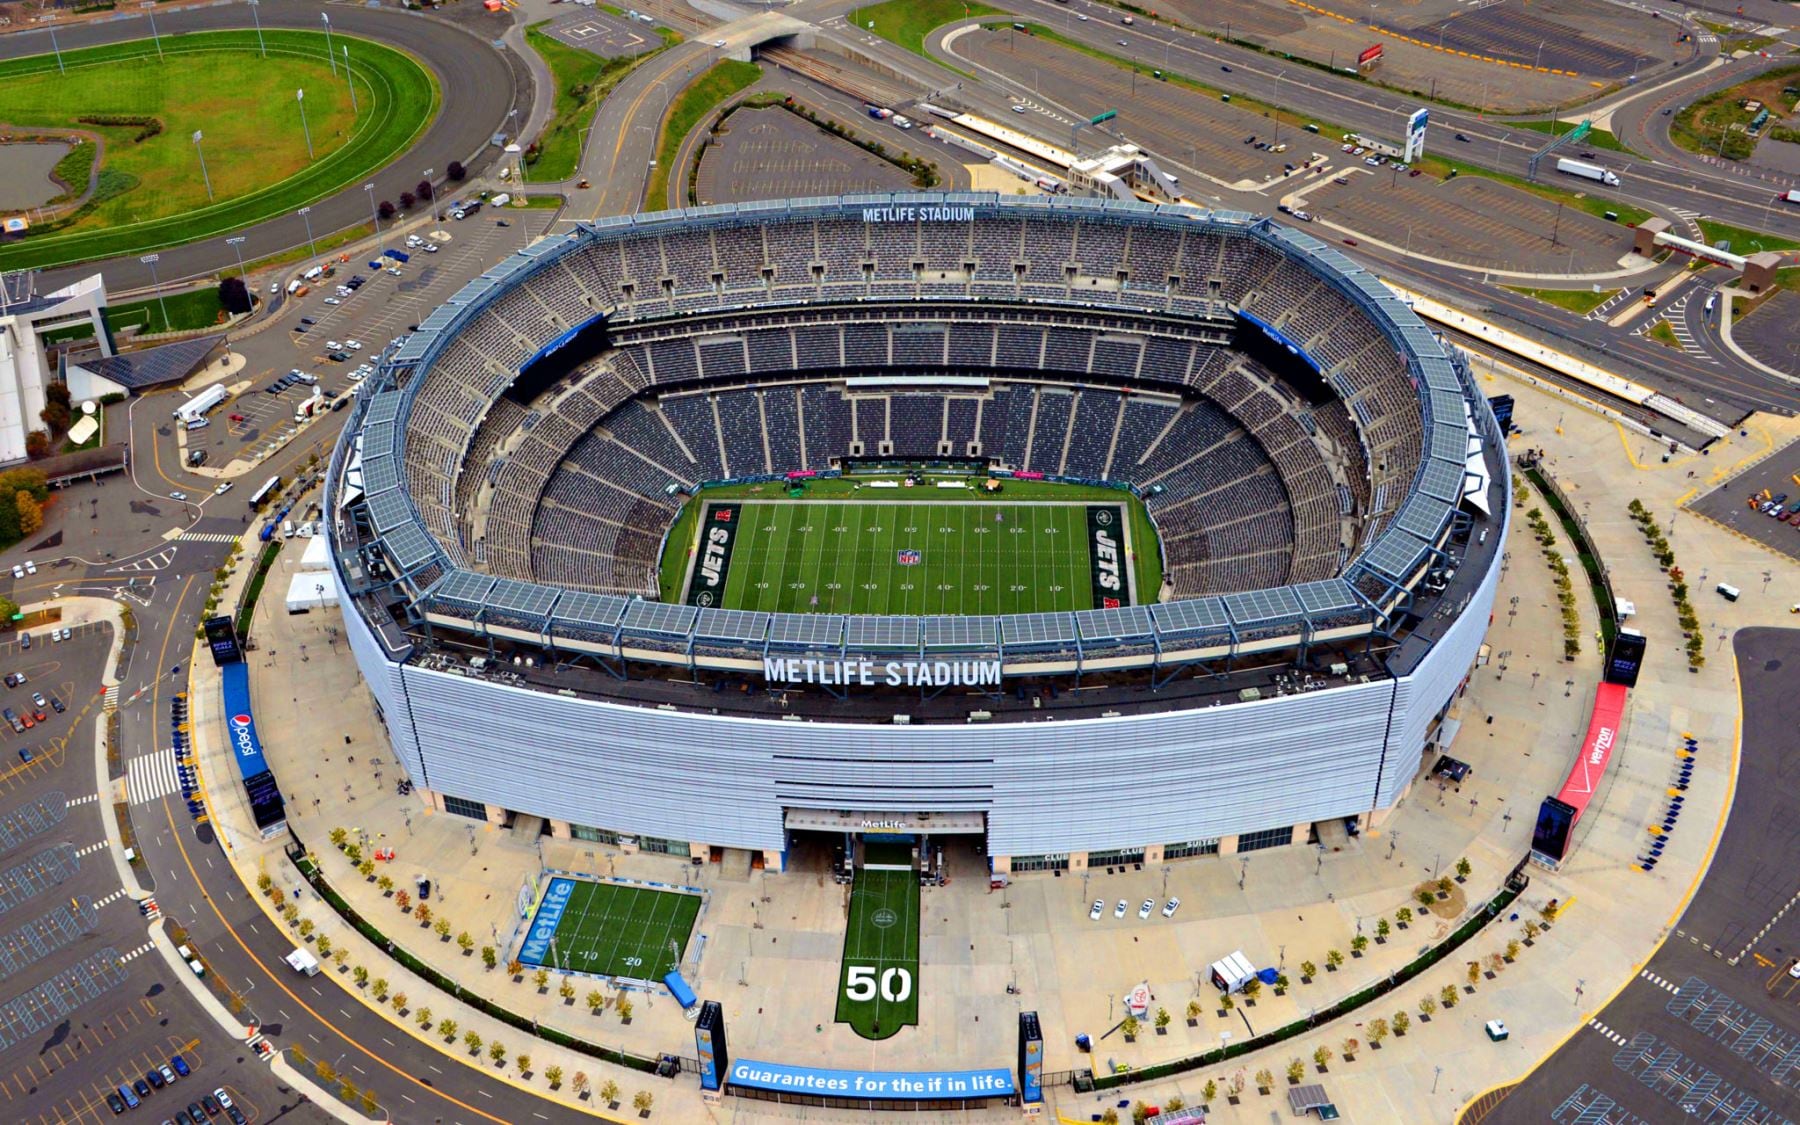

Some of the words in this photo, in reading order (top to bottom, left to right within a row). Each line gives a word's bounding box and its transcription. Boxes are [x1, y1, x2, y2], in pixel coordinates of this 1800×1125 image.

[863, 208, 915, 222] METLIFE
[920, 207, 975, 221] STADIUM
[701, 526, 729, 587] JETS
[1096, 529, 1121, 592] JETS
[764, 658, 874, 686] METLIFE
[885, 661, 1001, 687] STADIUM
[234, 727, 257, 757] pepsi
[1589, 727, 1614, 765] verizon
[861, 820, 906, 829] MetLife
[1044, 853, 1069, 861] CLUB
[1120, 848, 1145, 856] CLUB
[1187, 839, 1219, 848] SUITES
[522, 882, 571, 961] MetLife
[625, 956, 642, 967] 20
[846, 966, 912, 1003] 50
[735, 1065, 848, 1090] Guarantees
[855, 1076, 887, 1092] for
[891, 1078, 924, 1092] the
[928, 1077, 942, 1092] if
[948, 1076, 966, 1091] in
[971, 1075, 1012, 1090] life.
